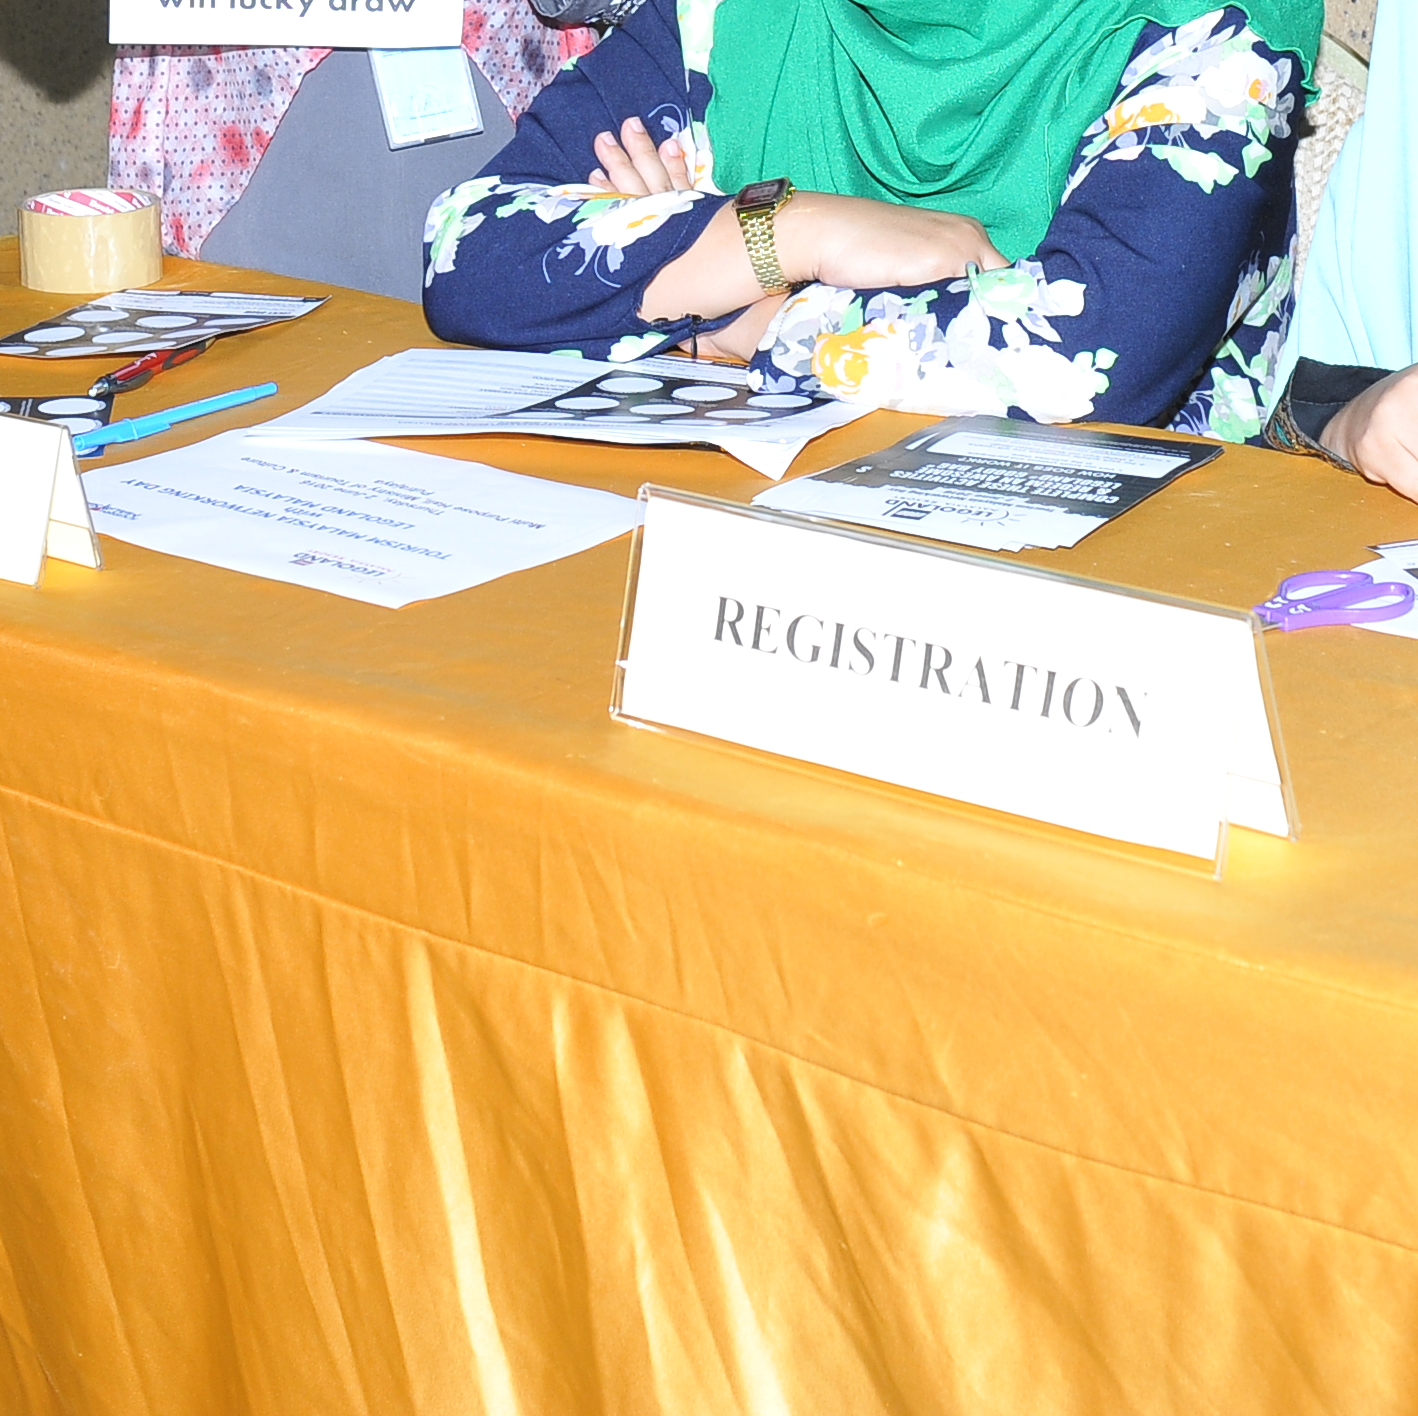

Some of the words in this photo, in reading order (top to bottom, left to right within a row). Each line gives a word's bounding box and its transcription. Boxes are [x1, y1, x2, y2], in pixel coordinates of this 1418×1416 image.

[240, 457, 286, 471] Culture
[957, 456, 1011, 467] WORK?
[914, 466, 1001, 482] AWESOME
[970, 466, 1029, 478] GOODY
[1033, 465, 1076, 474] DOES
[1077, 470, 1116, 479] HOW
[120, 479, 161, 490] DAY
[299, 471, 350, 485] Tourism
[889, 470, 981, 487] ACTIVITIES
[998, 476, 1027, 485] AN
[368, 486, 421, 501] Ministry
[977, 482, 1030, 493] THESE
[1024, 479, 1093, 493] REDEEM
[158, 487, 277, 518] NETWORKING
[233, 484, 322, 509] MALAYSIA
[1030, 487, 1120, 504] COMPLETE
[283, 506, 323, 518] with
[452, 506, 510, 522] Purpose
[884, 499, 993, 517] LEGOLAND
[320, 506, 415, 530] LEGOLAND
[508, 519, 546, 529] Multi
[276, 516, 368, 540] MALAYSIA
[365, 537, 452, 560] TOURISM
[293, 552, 386, 577] LEGOLAND
[713, 595, 1148, 739] REGISTRATION
